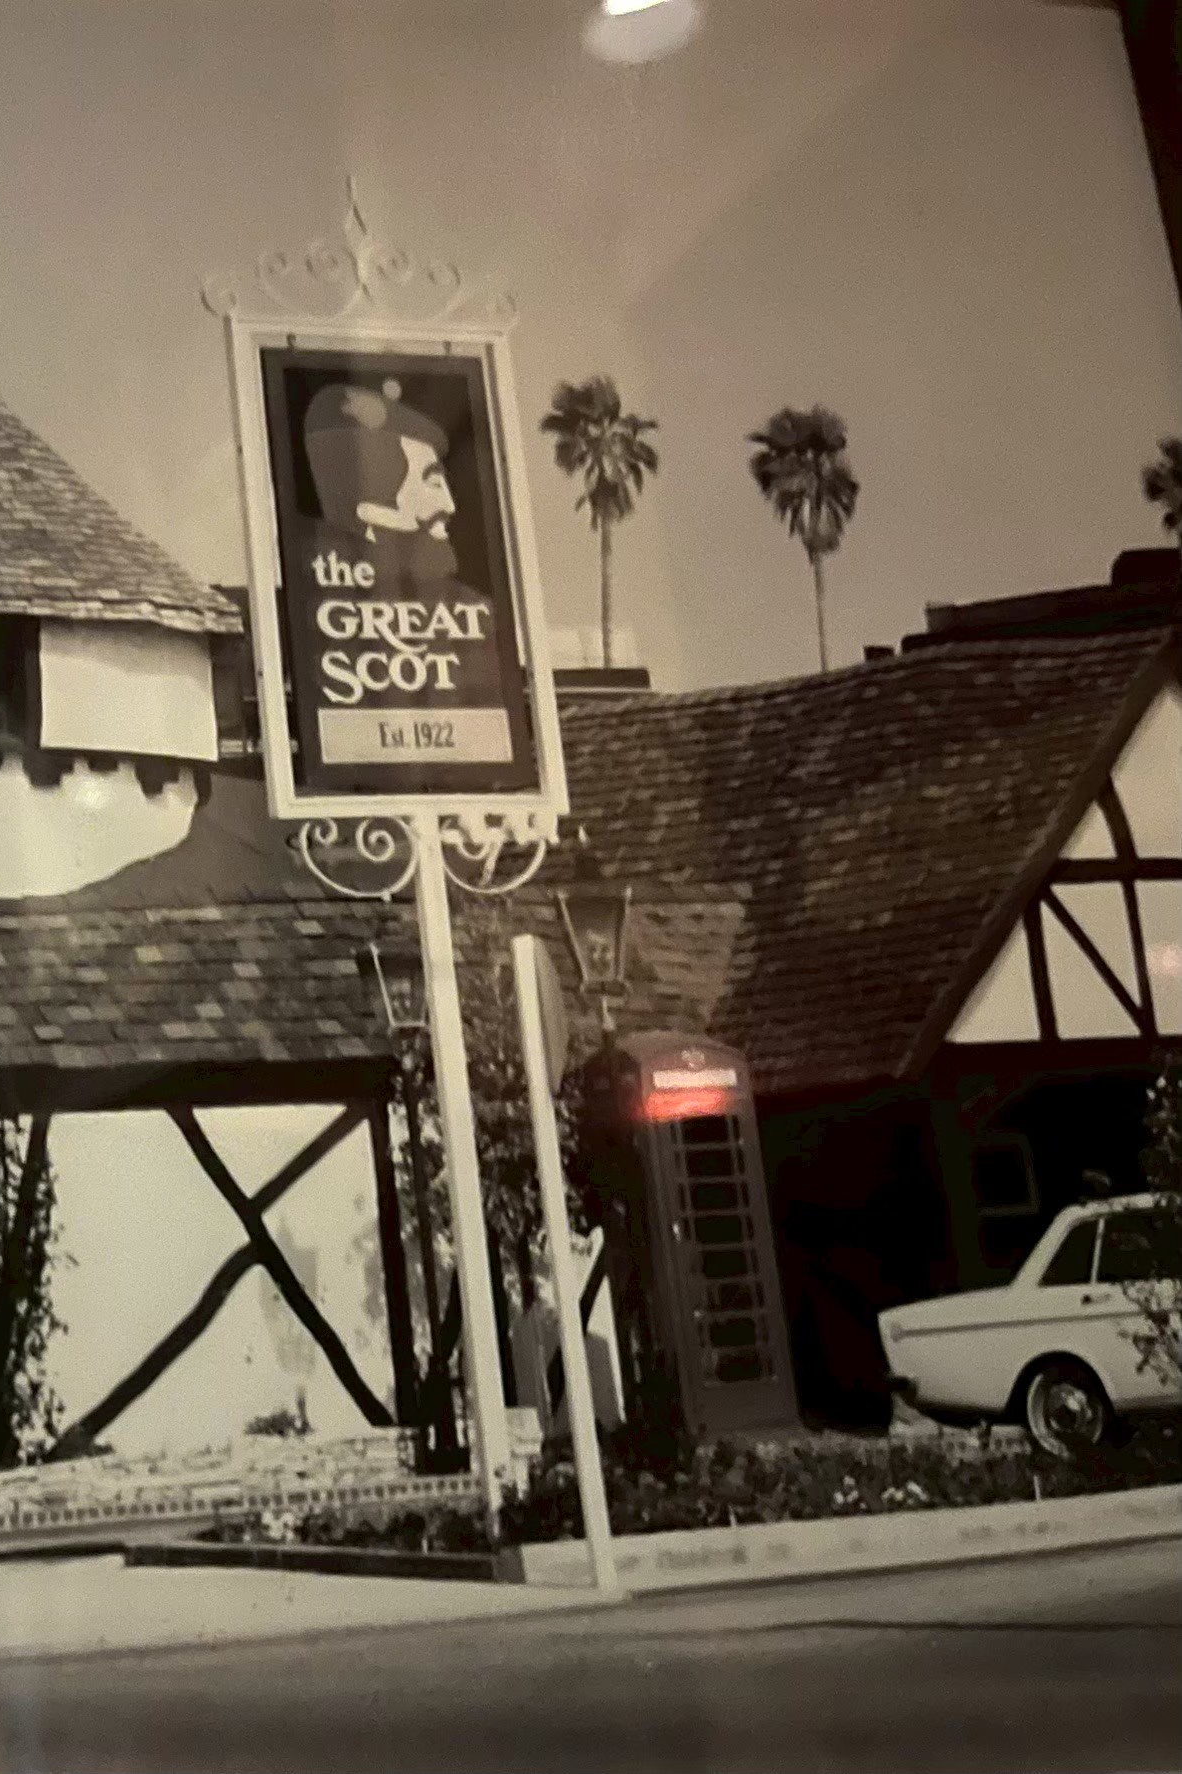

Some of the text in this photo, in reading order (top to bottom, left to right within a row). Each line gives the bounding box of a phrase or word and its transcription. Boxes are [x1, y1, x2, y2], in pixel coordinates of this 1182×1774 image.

[312, 550, 375, 588] the
[316, 600, 490, 652] GREAT
[321, 650, 460, 704] SCOT
[413, 721, 455, 748] 1922
